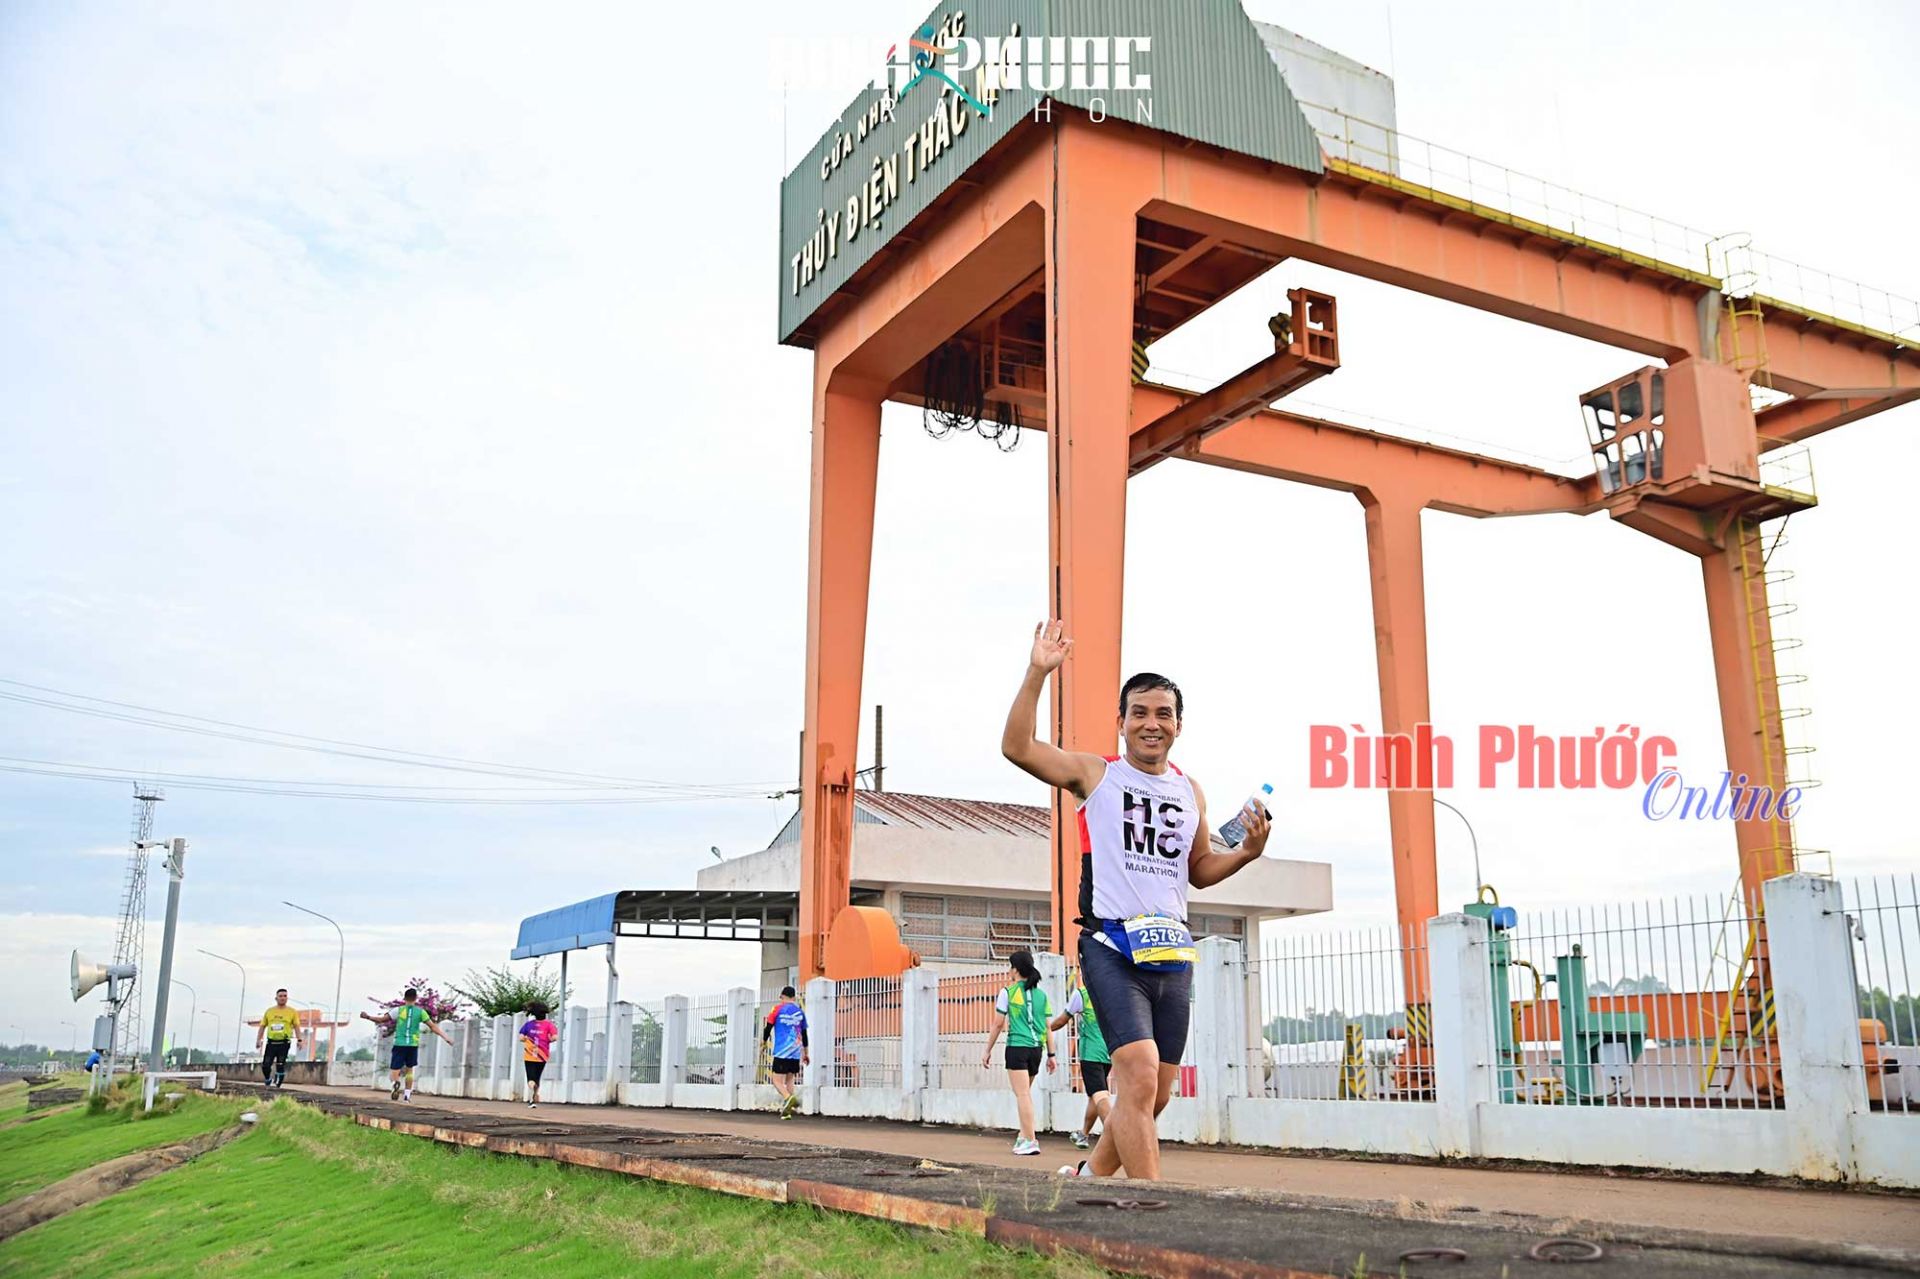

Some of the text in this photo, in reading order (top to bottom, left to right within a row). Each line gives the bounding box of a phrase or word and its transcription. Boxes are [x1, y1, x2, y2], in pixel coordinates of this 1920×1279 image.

[791, 207, 840, 296] THỦY
[846, 152, 898, 242] ĐIỆN
[1124, 852, 1178, 868] INTERNATIONAL
[1125, 862, 1179, 879] MARATHON
[1138, 928, 1185, 944] 25782
